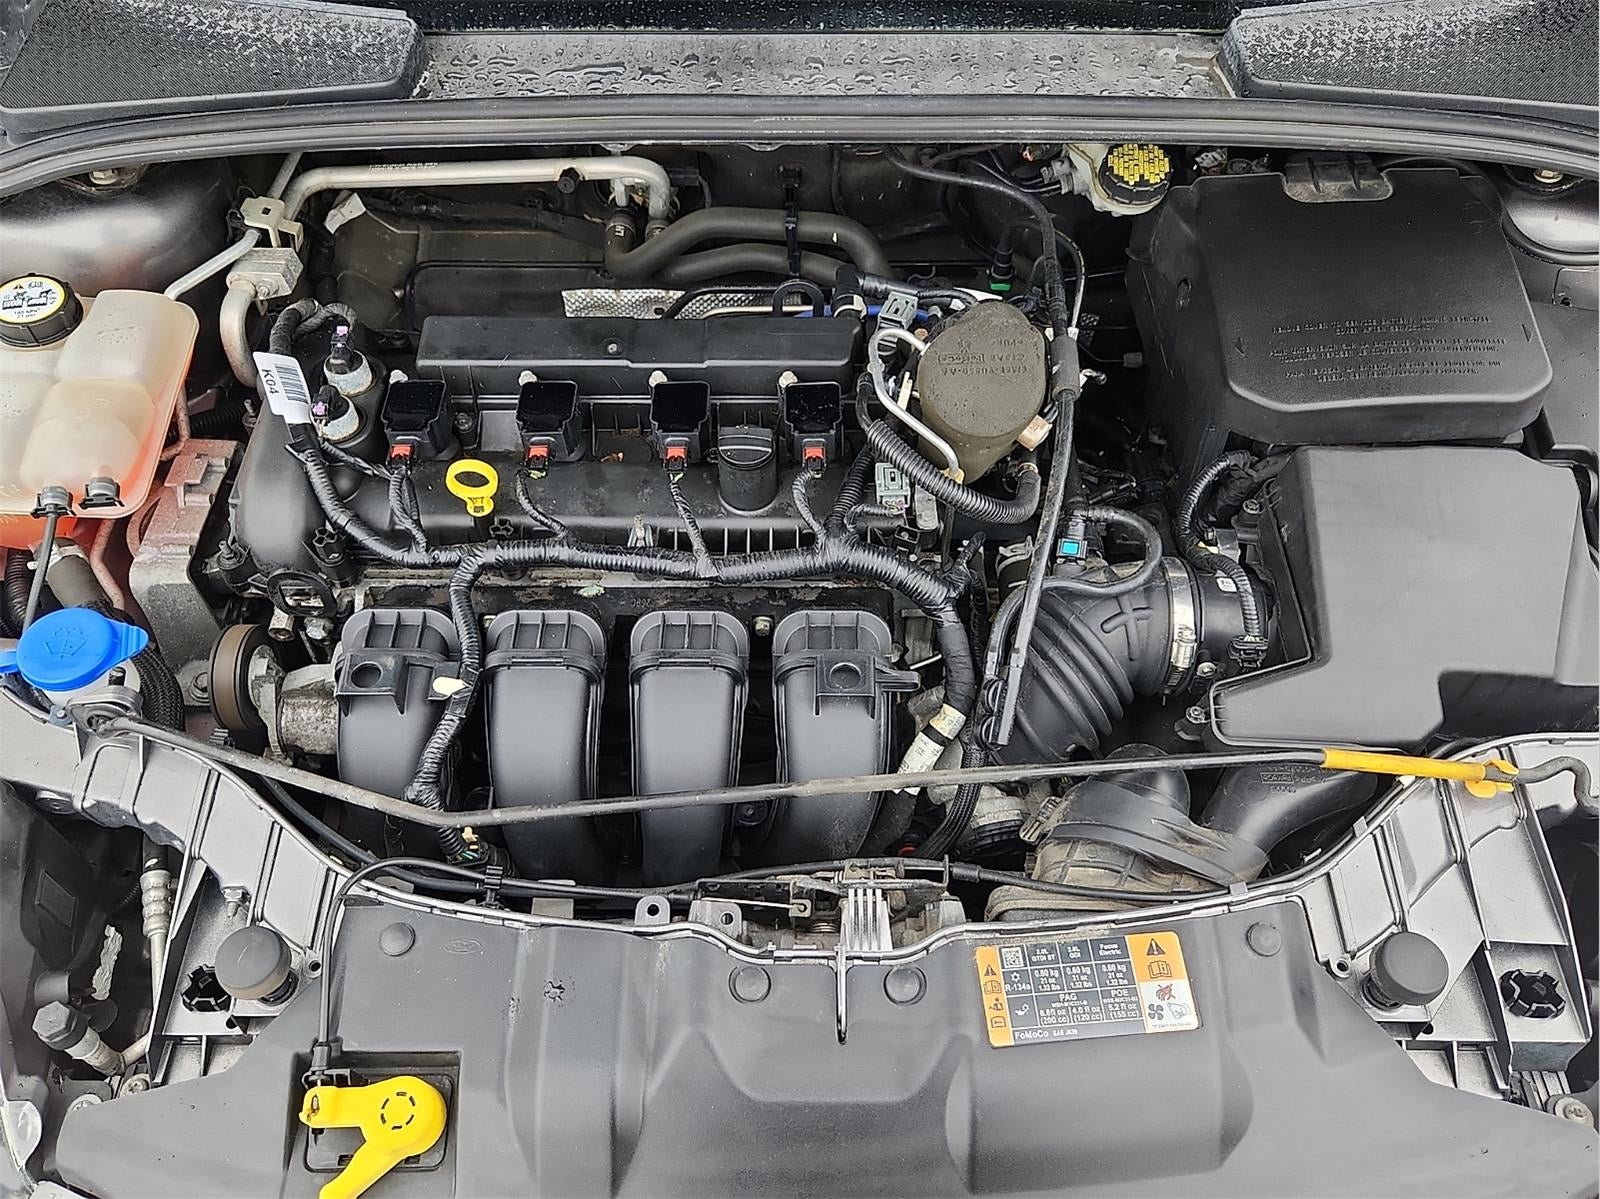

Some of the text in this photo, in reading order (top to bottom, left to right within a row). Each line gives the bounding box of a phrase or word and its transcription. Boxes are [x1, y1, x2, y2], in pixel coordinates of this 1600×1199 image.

[1049, 968, 1059, 978] kg
[1081, 966, 1091, 975] kg
[1101, 963, 1127, 973] 0.60 kg
[1005, 982, 1031, 992] R-134a
[1082, 980, 1093, 988] lbs
[1059, 992, 1077, 1002] PAG
[1110, 989, 1129, 998] POE
[1071, 1006, 1083, 1014] 4.0
[1083, 1005, 1090, 1013] fl
[1108, 1002, 1137, 1011] 5.2 fl oz
[1073, 1012, 1103, 1023] (120 cc)
[1110, 1010, 1139, 1020] (155 cc)
[1040, 1015, 1070, 1026] (200 cc)
[1014, 1029, 1049, 1040] FoMoCo
